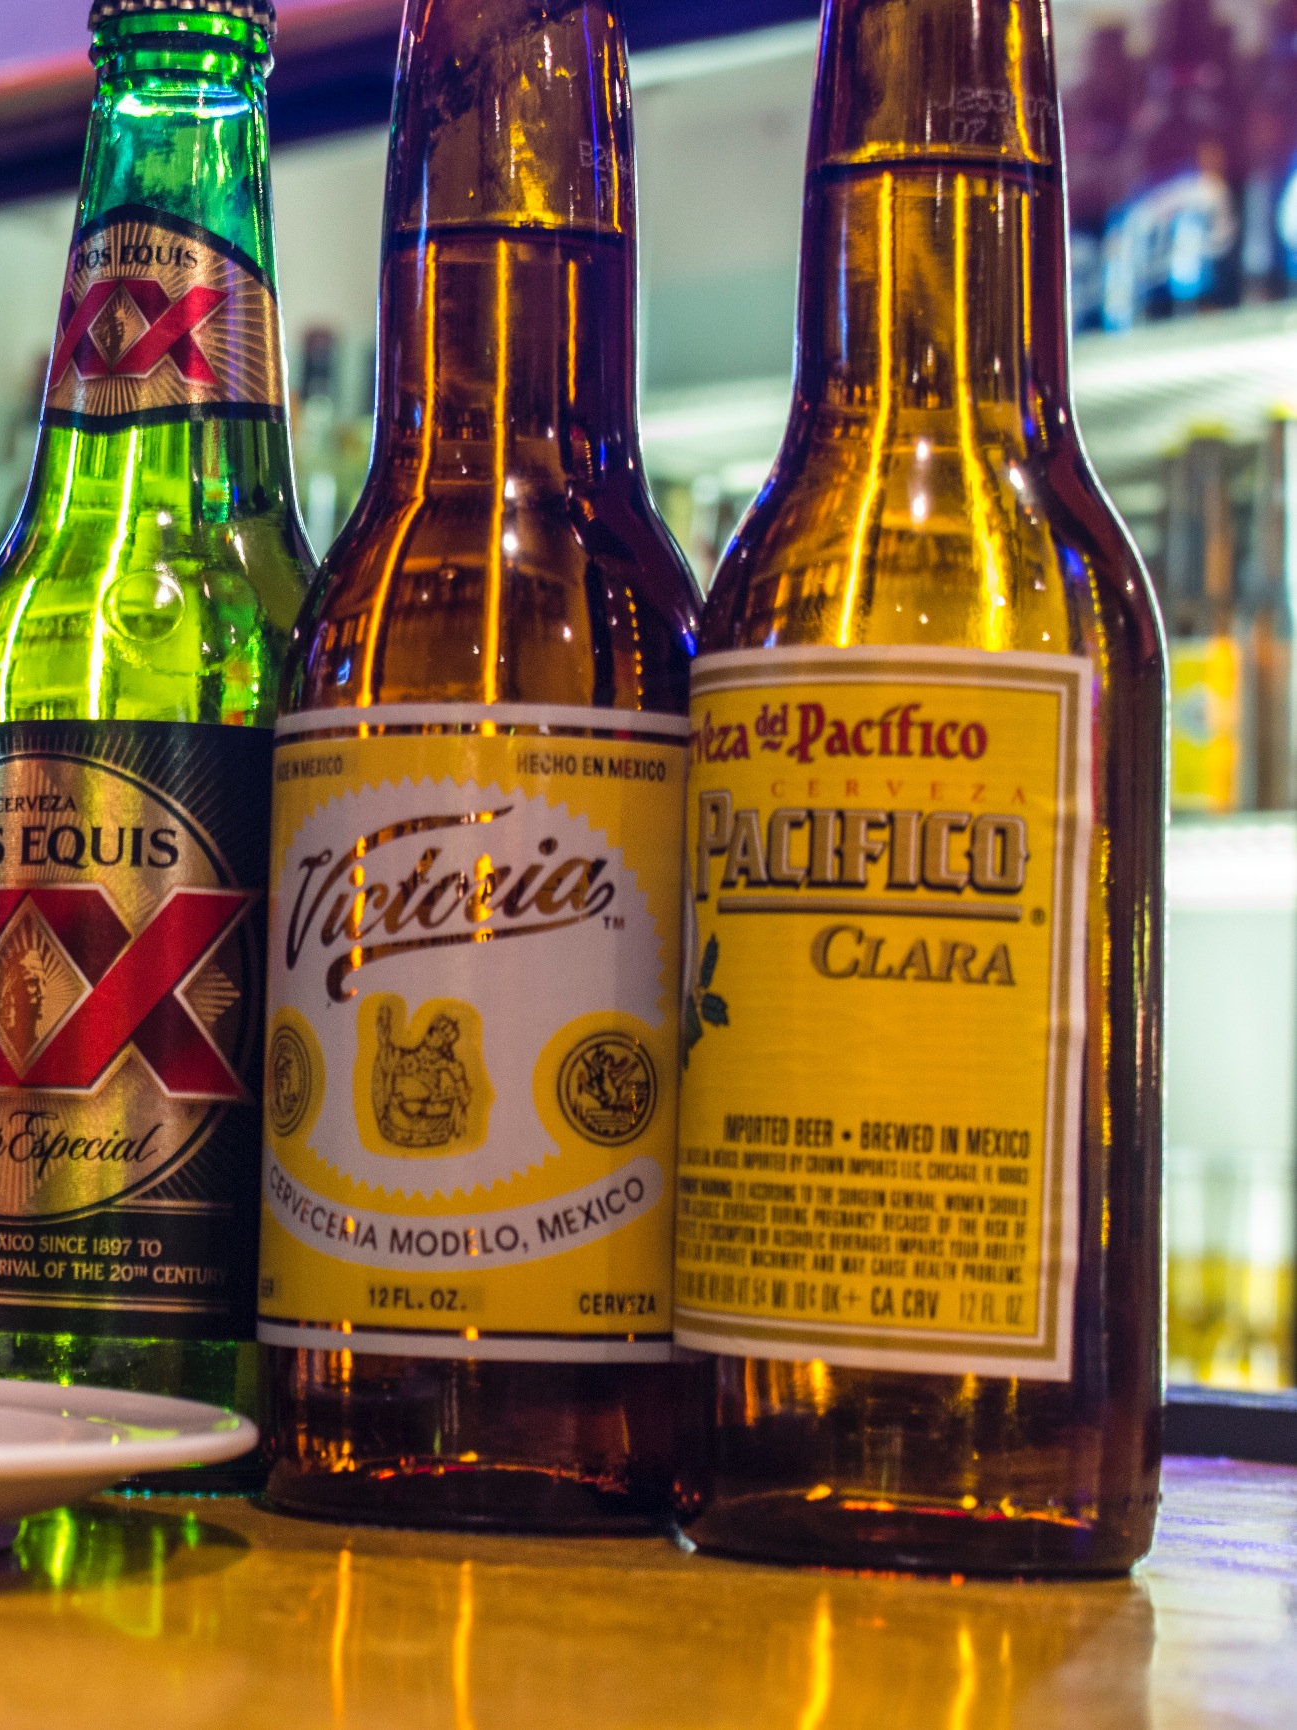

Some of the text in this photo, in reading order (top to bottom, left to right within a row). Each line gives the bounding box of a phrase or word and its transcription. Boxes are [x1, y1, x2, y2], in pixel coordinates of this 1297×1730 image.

[75, 245, 199, 273] DOS EQUIS
[754, 703, 789, 738] del
[301, 754, 343, 778] MEXICO
[517, 753, 667, 783] HECHO EN MEXICO
[769, 777, 1027, 806] CERVEZA
[20, 825, 180, 870] EQUIS
[697, 788, 1030, 903] PACIFICO
[285, 803, 616, 1003] Victoria
[810, 923, 1017, 988] CLARA
[7, 1109, 165, 1181] Especial
[794, 1116, 833, 1148] BEER
[859, 1120, 935, 1154] BREWED
[941, 1124, 960, 1155] IN
[966, 1126, 1031, 1160] MEXICO
[269, 1165, 645, 1258] CERVECERIA MODELO, MEXICO
[814, 1208, 877, 1230] PREGNANCY
[882, 1212, 931, 1234] BECAUSE
[937, 1215, 951, 1236] OF
[958, 1216, 978, 1237] THE
[984, 1218, 1009, 1240] RISK
[1014, 1220, 1027, 1241] OF
[38, 1236, 88, 1256] SINCE
[92, 1237, 132, 1257] 1897
[137, 1239, 163, 1258] TO
[830, 1232, 891, 1255] BEVERAGES
[895, 1236, 945, 1258] IMPAIRS
[949, 1240, 980, 1260] YOUR
[984, 1241, 1027, 1262] ABILITY
[43, 1260, 68, 1280] OF
[71, 1261, 105, 1281] THE
[812, 1253, 835, 1273] AND
[840, 1255, 866, 1275] MAY
[870, 1257, 907, 1278] CAUSE
[914, 1260, 957, 1281] HEALTH
[962, 1263, 1023, 1286] PROBLEMS.
[429, 1288, 467, 1311] OZ.
[579, 1292, 657, 1316] CERVEZA
[870, 1286, 896, 1318] CA
[901, 1287, 941, 1320] CRV
[959, 1290, 978, 1324] 12
